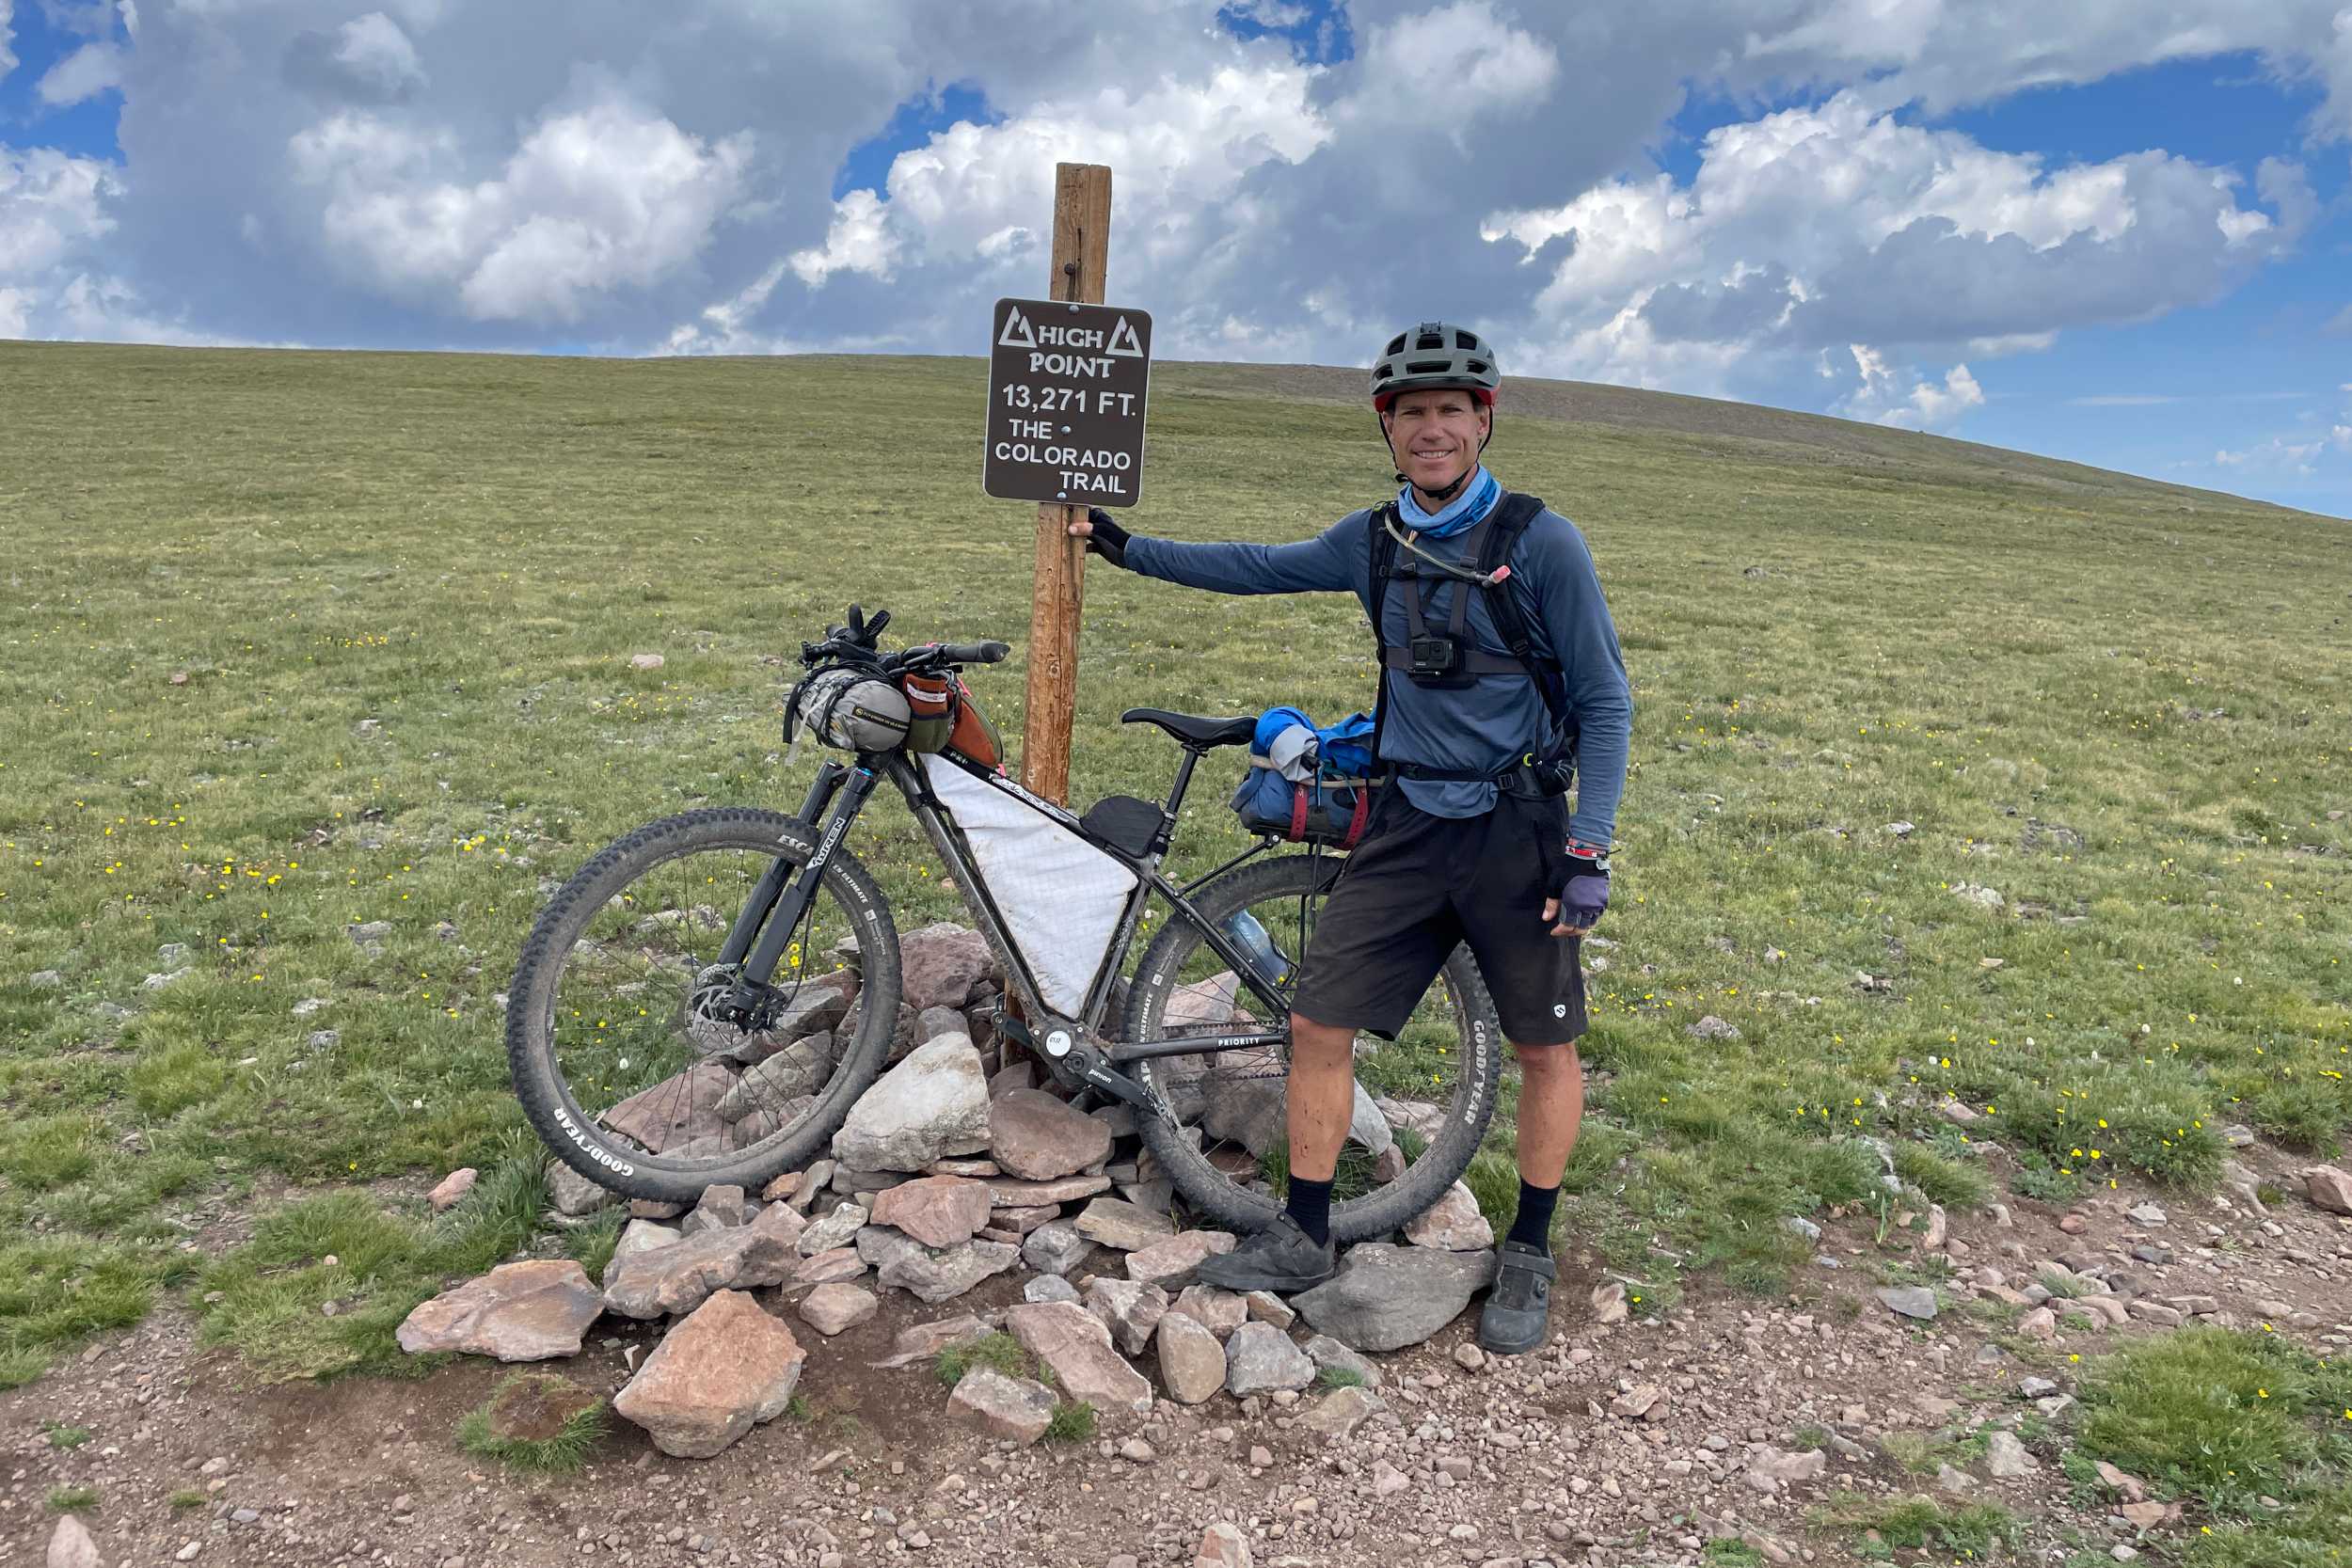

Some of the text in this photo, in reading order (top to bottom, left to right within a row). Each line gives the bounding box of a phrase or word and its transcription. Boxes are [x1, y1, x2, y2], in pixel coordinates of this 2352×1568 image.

[1039, 325, 1104, 349] HIGH
[1029, 353, 1116, 378] POINT
[1003, 384, 1136, 416] 13,271 FT.
[1009, 419, 1053, 439] THE
[995, 442, 1131, 470] COLORADO
[1059, 471, 1127, 494] TRAIL
[842, 872, 868, 904] ULTIMATE
[1140, 991, 1153, 1034] ULTIMATE
[1218, 1037, 1260, 1047] PRIORITY
[1088, 1069, 1112, 1084] pinion
[1464, 1020, 1486, 1125] GOODYEAR
[553, 1107, 634, 1177] GOODYEAR
